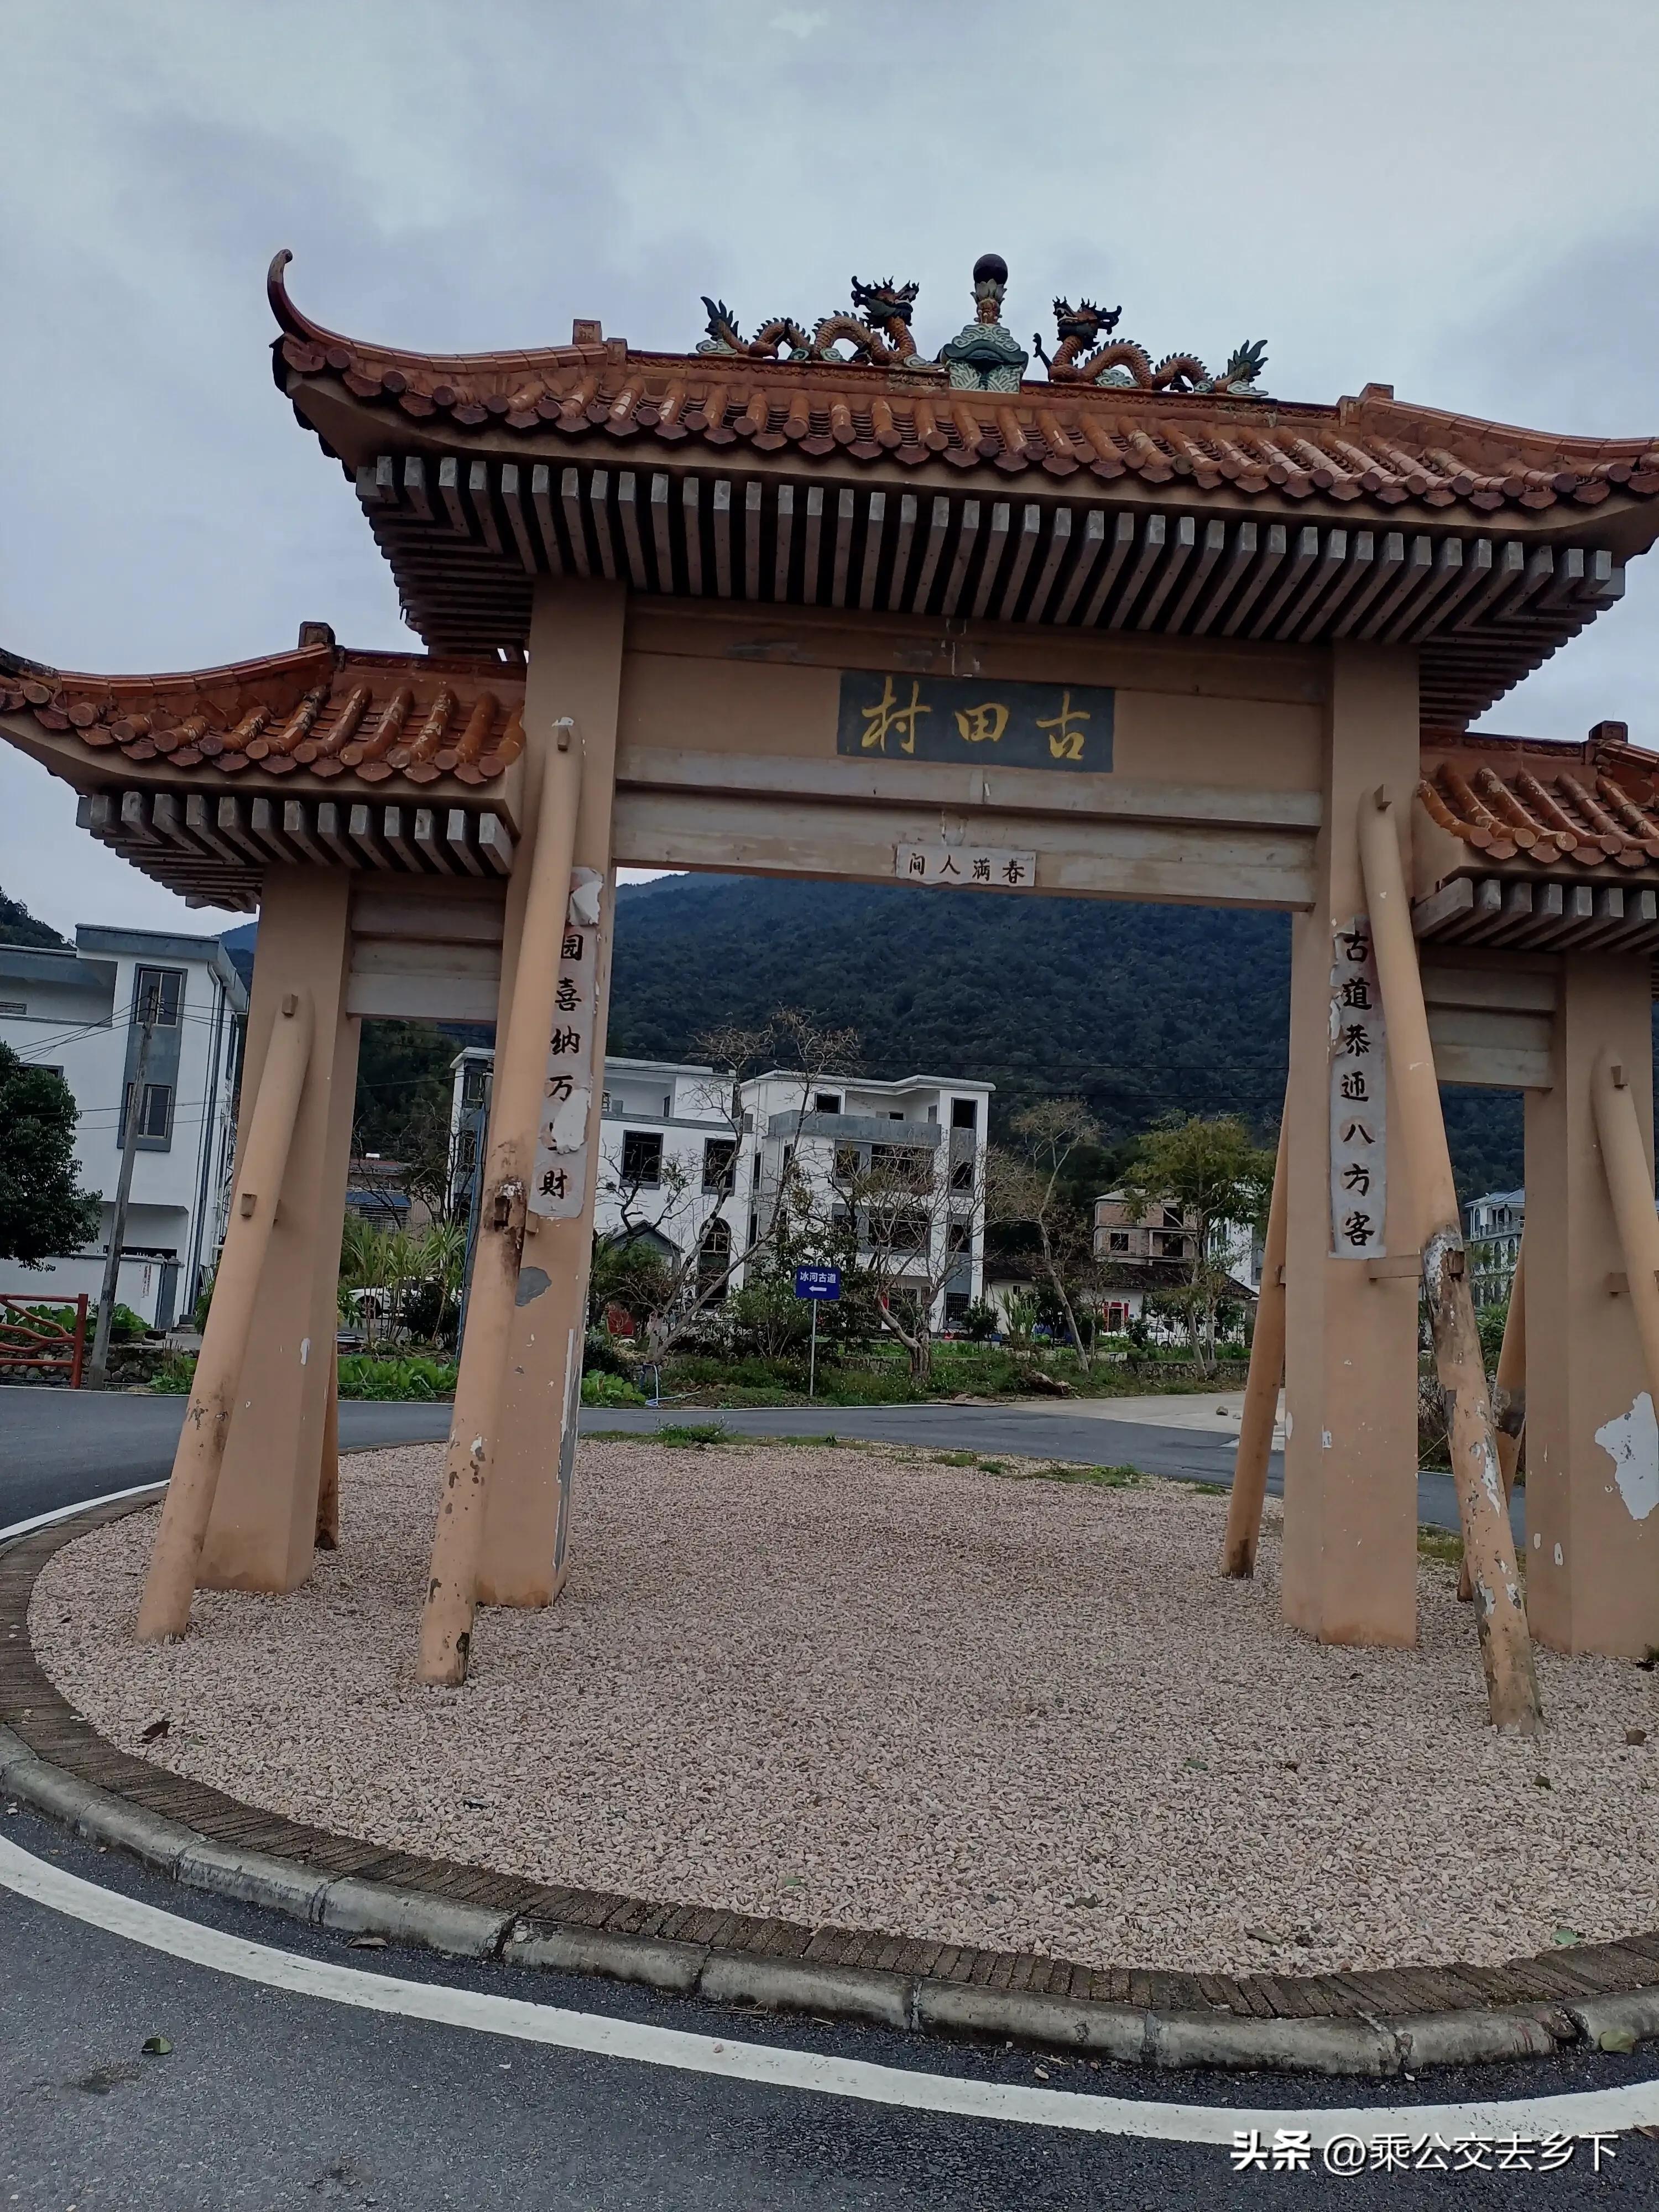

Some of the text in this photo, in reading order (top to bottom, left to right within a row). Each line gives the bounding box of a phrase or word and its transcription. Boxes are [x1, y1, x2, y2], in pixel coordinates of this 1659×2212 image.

[862, 676, 1091, 760] 古田村
[909, 852, 1025, 884] 春满人间
[800, 1271, 836, 1284] 冰河古道
